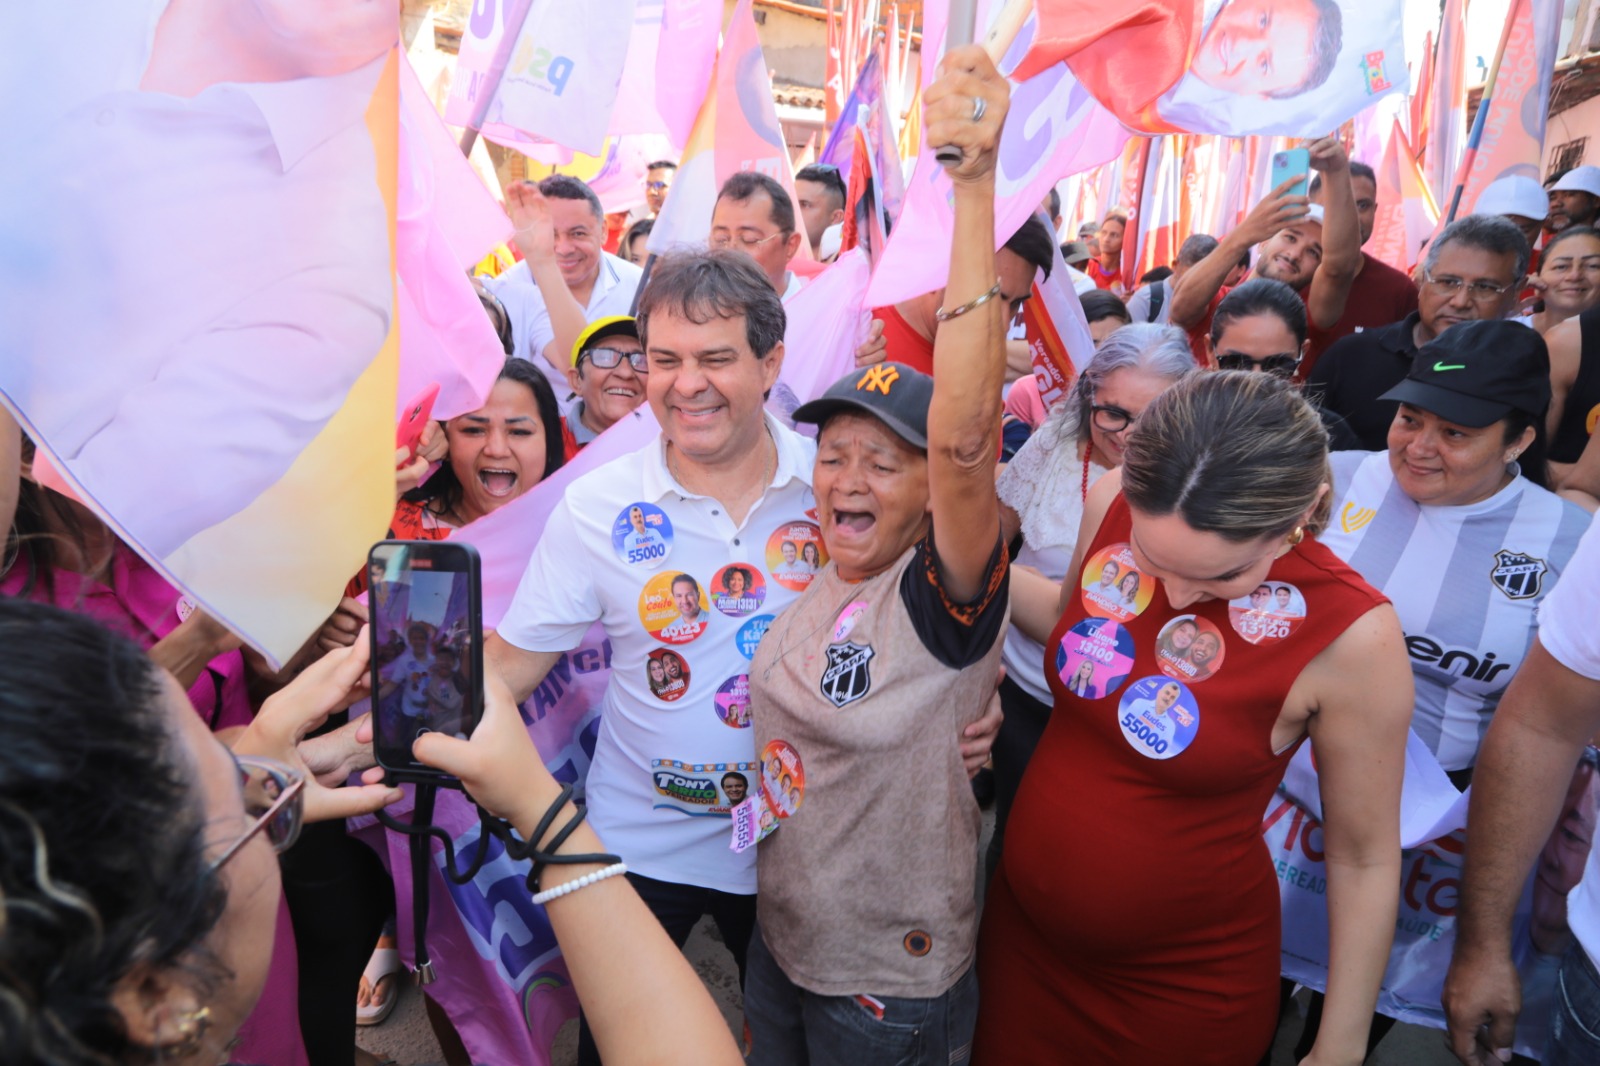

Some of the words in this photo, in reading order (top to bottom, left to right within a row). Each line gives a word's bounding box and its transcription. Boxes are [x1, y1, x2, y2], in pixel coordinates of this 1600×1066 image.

[1034, 338, 1065, 384] Vereador
[857, 364, 899, 395] NY
[628, 543, 666, 564] 55000
[647, 598, 672, 611] Couto
[661, 622, 701, 638] 40123
[1239, 621, 1290, 639] 13120
[1079, 639, 1114, 663] 13100
[1401, 631, 1511, 683] enir
[1142, 709, 1168, 732] Eudes
[1121, 712, 1169, 755] 55000
[657, 773, 710, 790] TONY
[668, 783, 716, 799] BRITO
[737, 806, 749, 849] 55555
